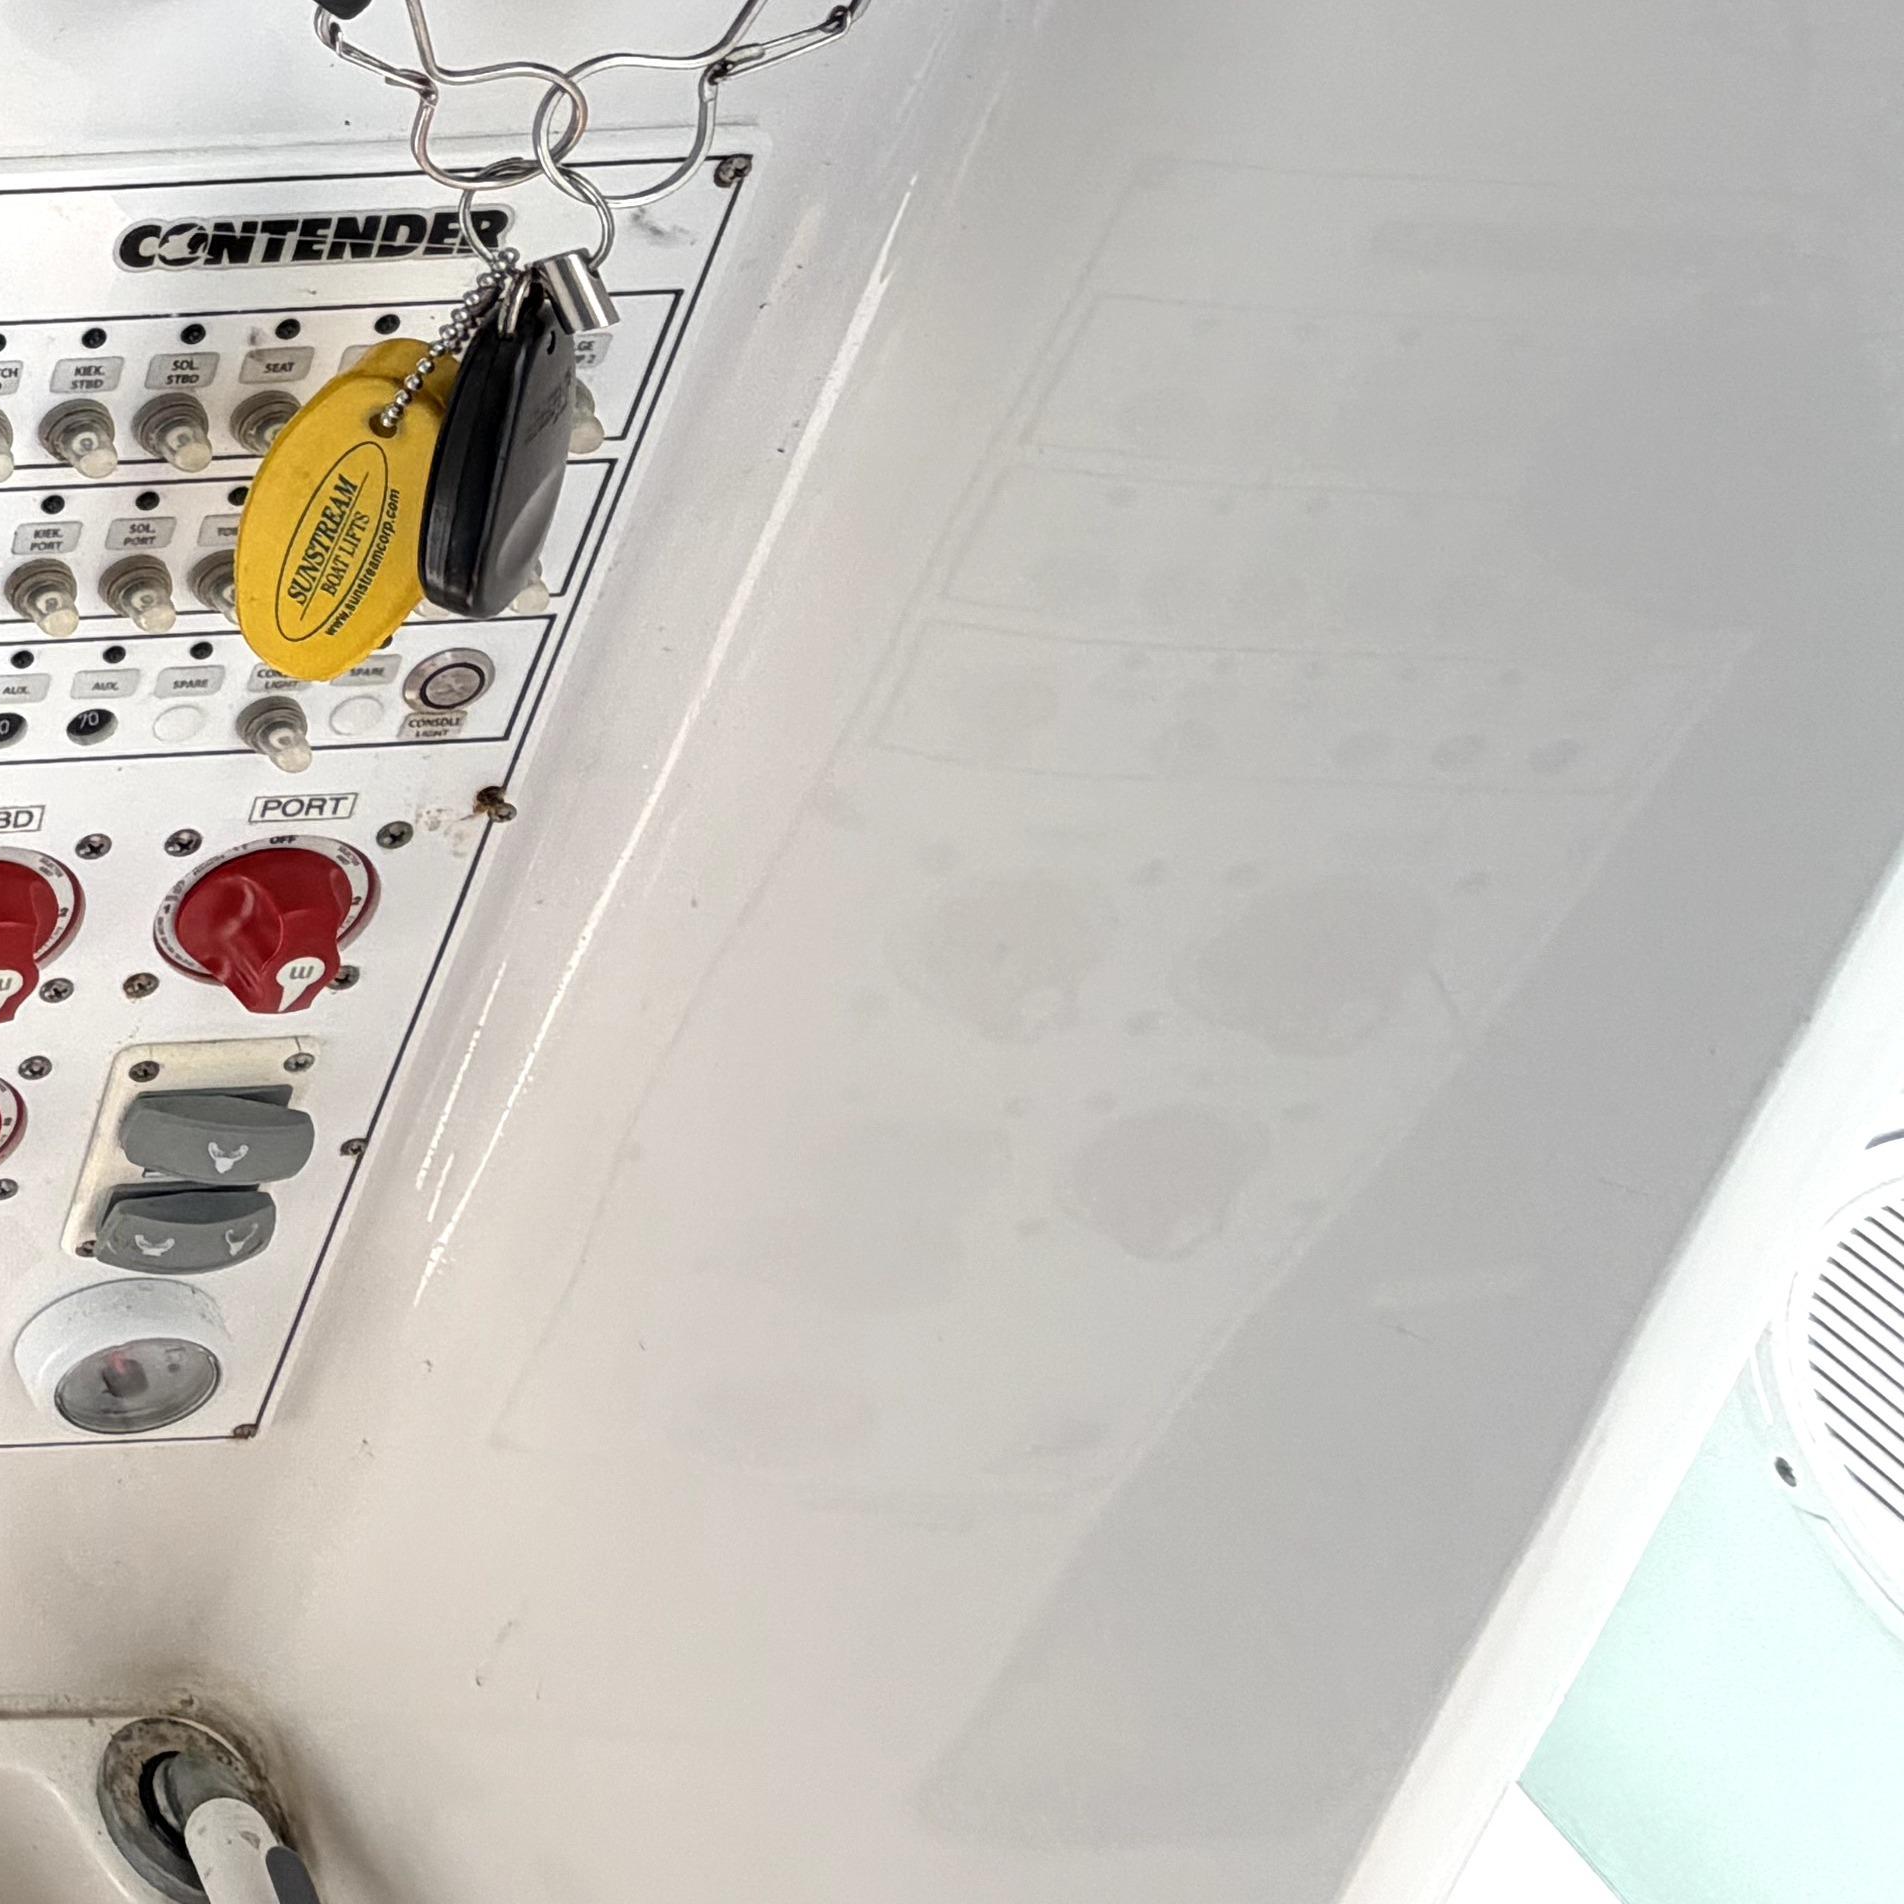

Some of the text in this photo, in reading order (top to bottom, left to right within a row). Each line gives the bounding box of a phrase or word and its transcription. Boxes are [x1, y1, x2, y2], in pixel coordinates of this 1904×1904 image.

[117, 209, 509, 269] CONTENDER
[263, 361, 296, 374] SEAT
[70, 378, 105, 391] STBD
[166, 373, 200, 385] STBD
[29, 540, 64, 552] PORT
[123, 534, 157, 547] PORT
[287, 472, 359, 607] SUNSTREAM
[321, 511, 370, 597] BOAT LIFTS
[325, 488, 401, 637] www.sunstreamcorp.com
[349, 666, 385, 678] SPARE
[173, 678, 209, 689] SPARE
[264, 680, 299, 690] LIGHT
[78, 710, 100, 729] 70
[408, 717, 461, 729] CONSOLE
[414, 729, 449, 739] LIGHT
[260, 796, 349, 818] PORT
[269, 835, 296, 845] OFF
